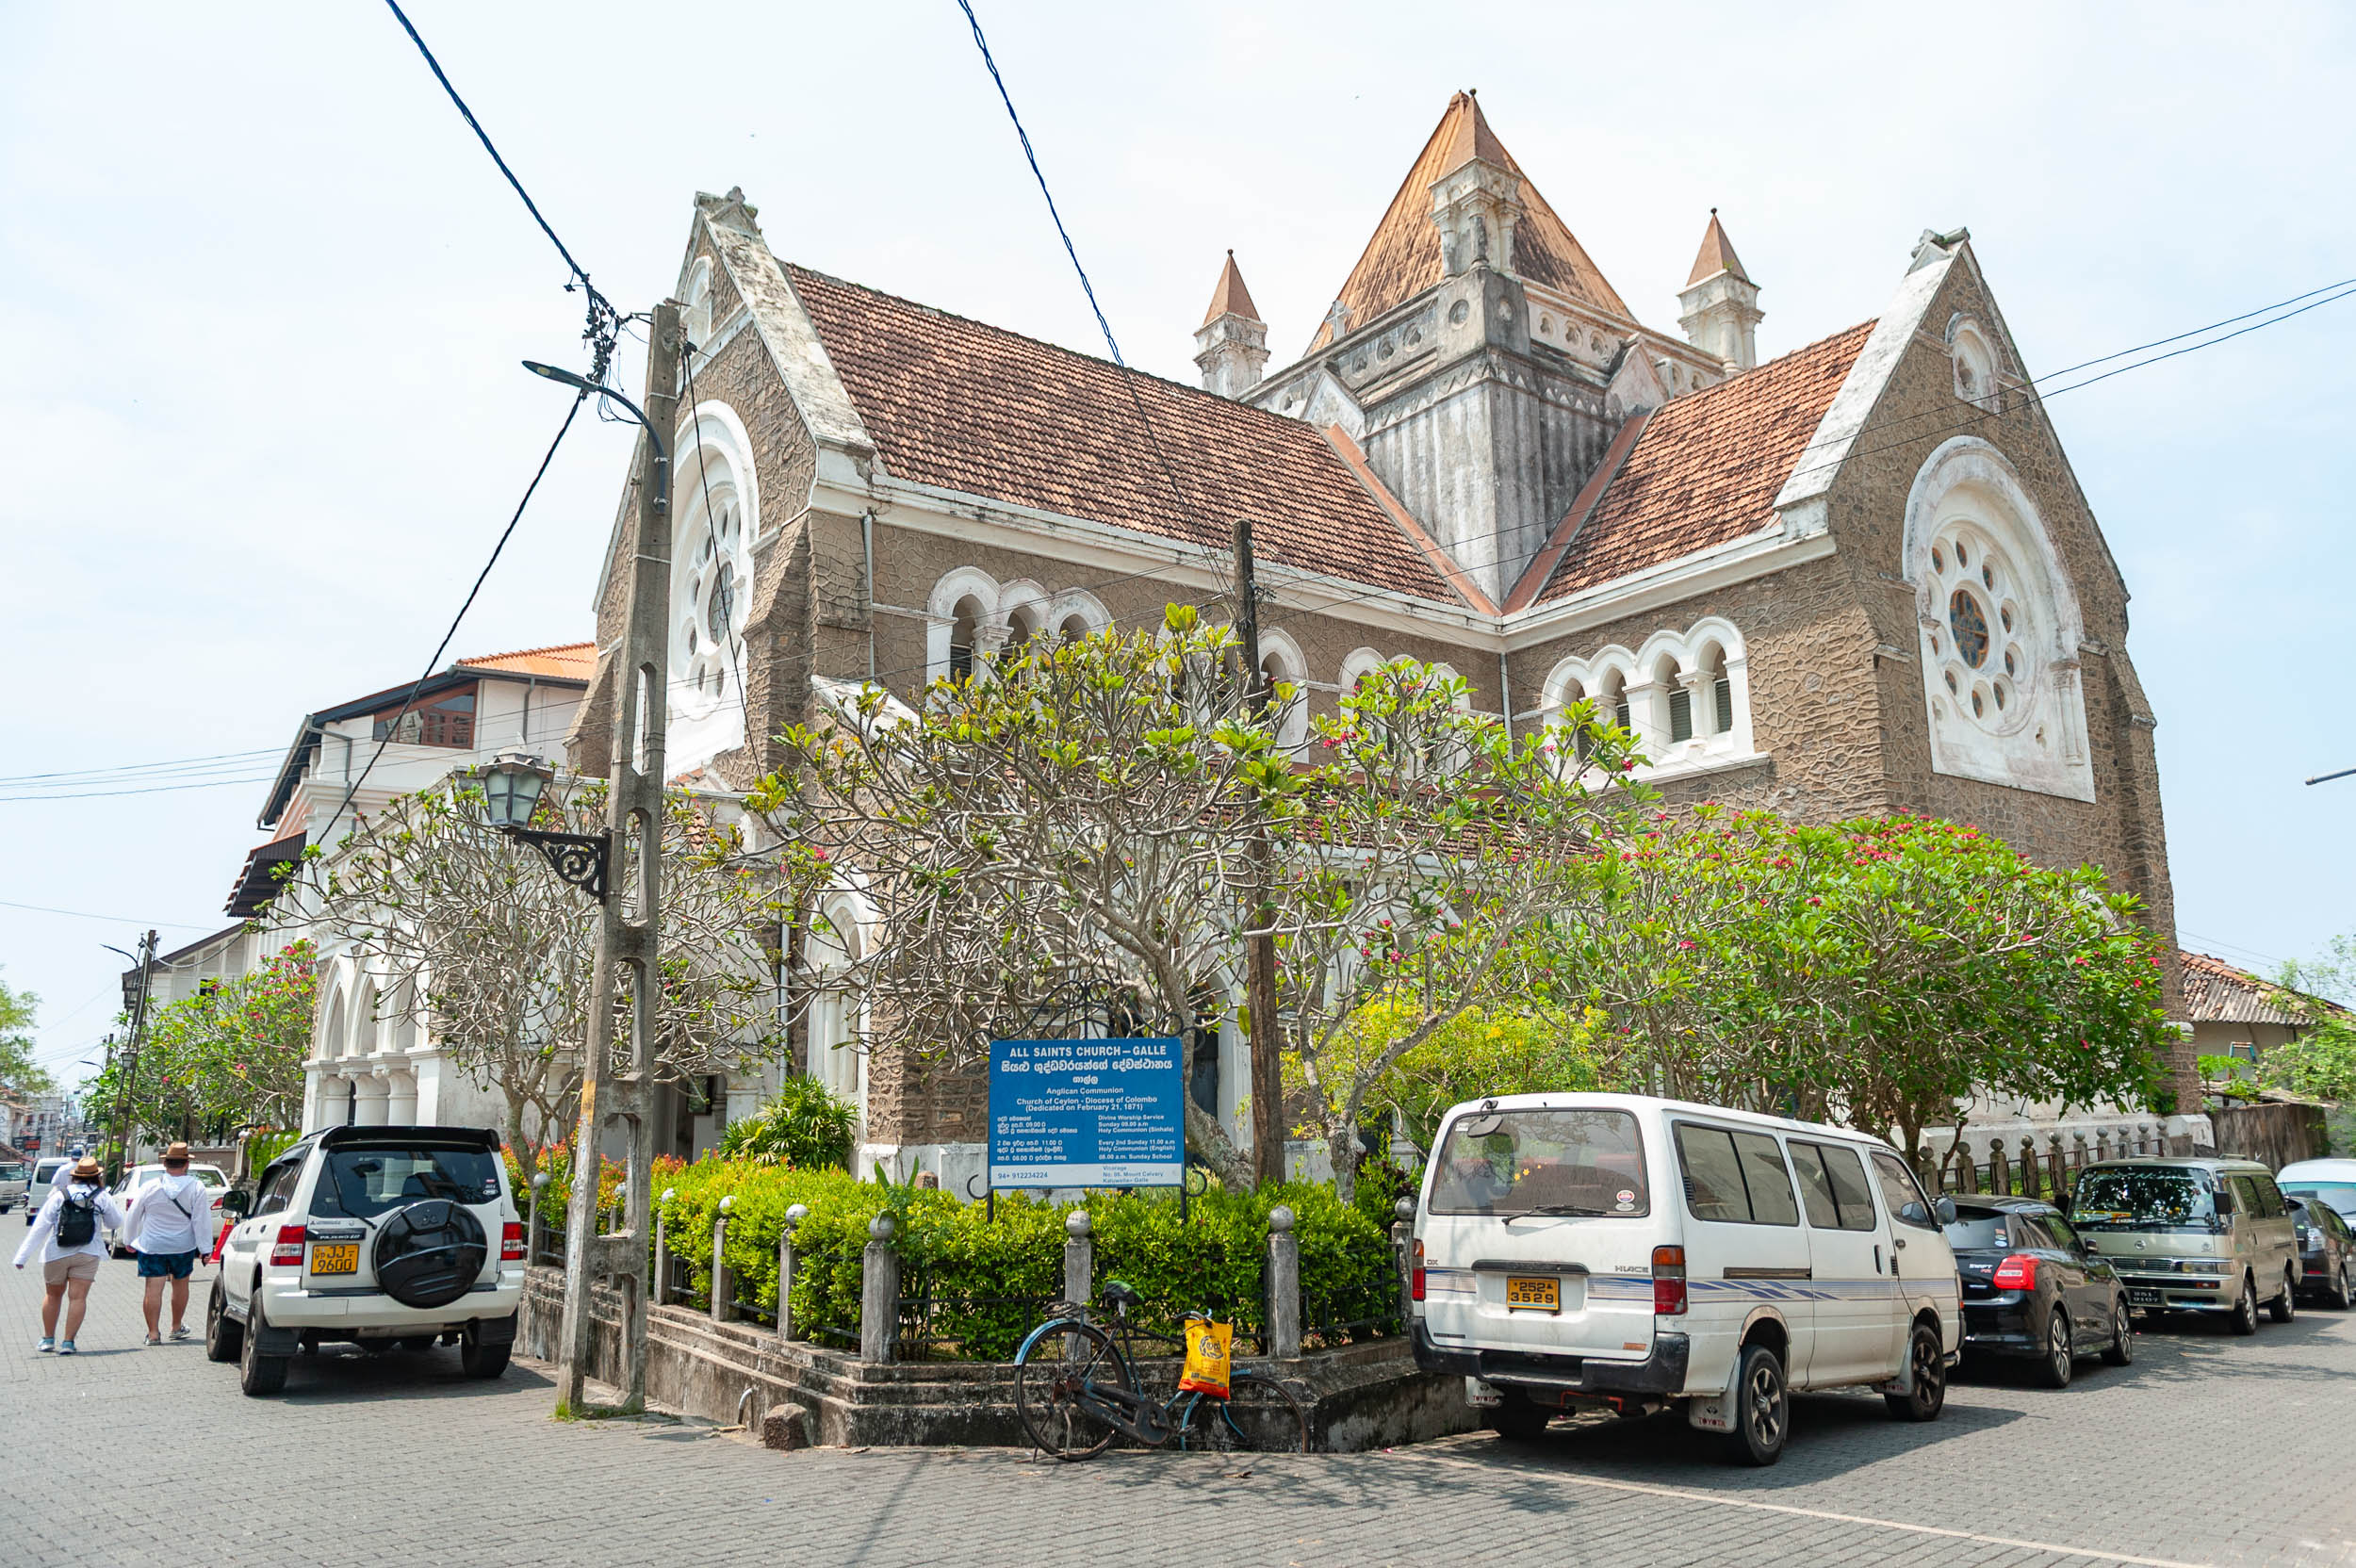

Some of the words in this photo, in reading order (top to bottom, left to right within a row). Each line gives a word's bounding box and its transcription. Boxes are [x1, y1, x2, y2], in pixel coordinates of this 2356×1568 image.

[1009, 1048, 1029, 1057] ALL
[1034, 1047, 1072, 1057] SAINTS
[1076, 1046, 1121, 1056] CHURCH
[1133, 1045, 1167, 1055] GALLE
[1046, 1086, 1078, 1096] Anglican
[1054, 1097, 1079, 1106] Ceylon
[1124, 1095, 1158, 1103] Colombo
[1025, 1104, 1064, 1113] (Dedicated
[1077, 1103, 1109, 1112] February
[1123, 1102, 1143, 1111] 1871)
[318, 1258, 352, 1272] 9600
[1519, 1282, 1546, 1292] 252
[1511, 1291, 1554, 1304] 3529
[1472, 1395, 1497, 1403] TOYOTA
[1698, 1416, 1726, 1428] TOYOTA
